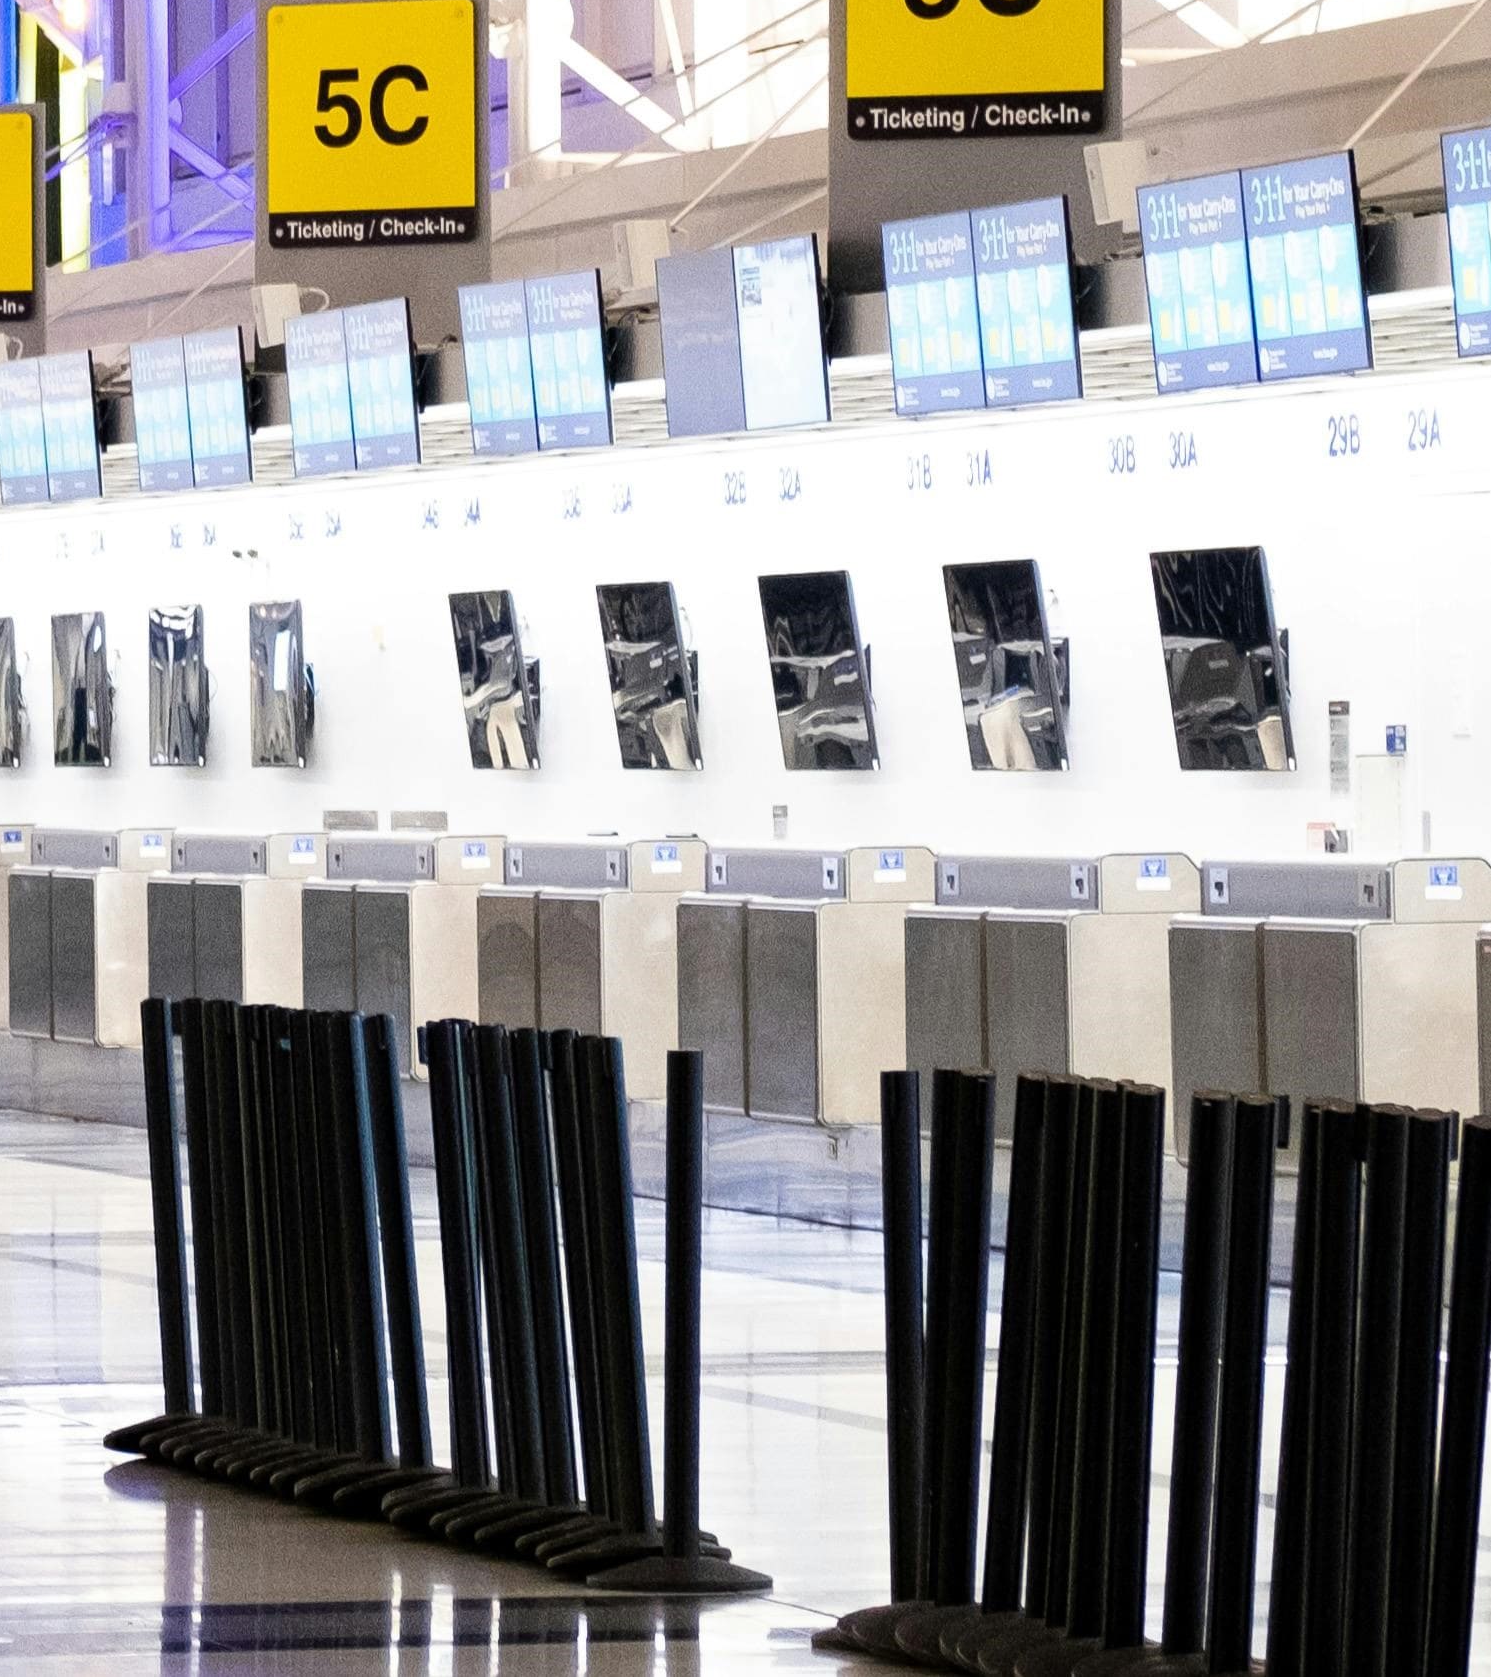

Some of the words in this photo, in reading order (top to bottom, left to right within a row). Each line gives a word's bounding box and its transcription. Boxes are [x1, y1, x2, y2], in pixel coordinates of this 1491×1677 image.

[313, 64, 429, 148] 5C
[870, 107, 965, 132] Ticketing
[971, 106, 979, 129] /
[985, 103, 1079, 126] Check-In
[287, 220, 364, 241] Ticketing
[368, 219, 375, 239] /
[380, 217, 455, 238] Check-In
[1328, 414, 1360, 457] 29B
[1408, 409, 1441, 451] 29A
[966, 448, 993, 487] 31A
[1107, 435, 1136, 474] 30B
[1169, 431, 1197, 469] 30A
